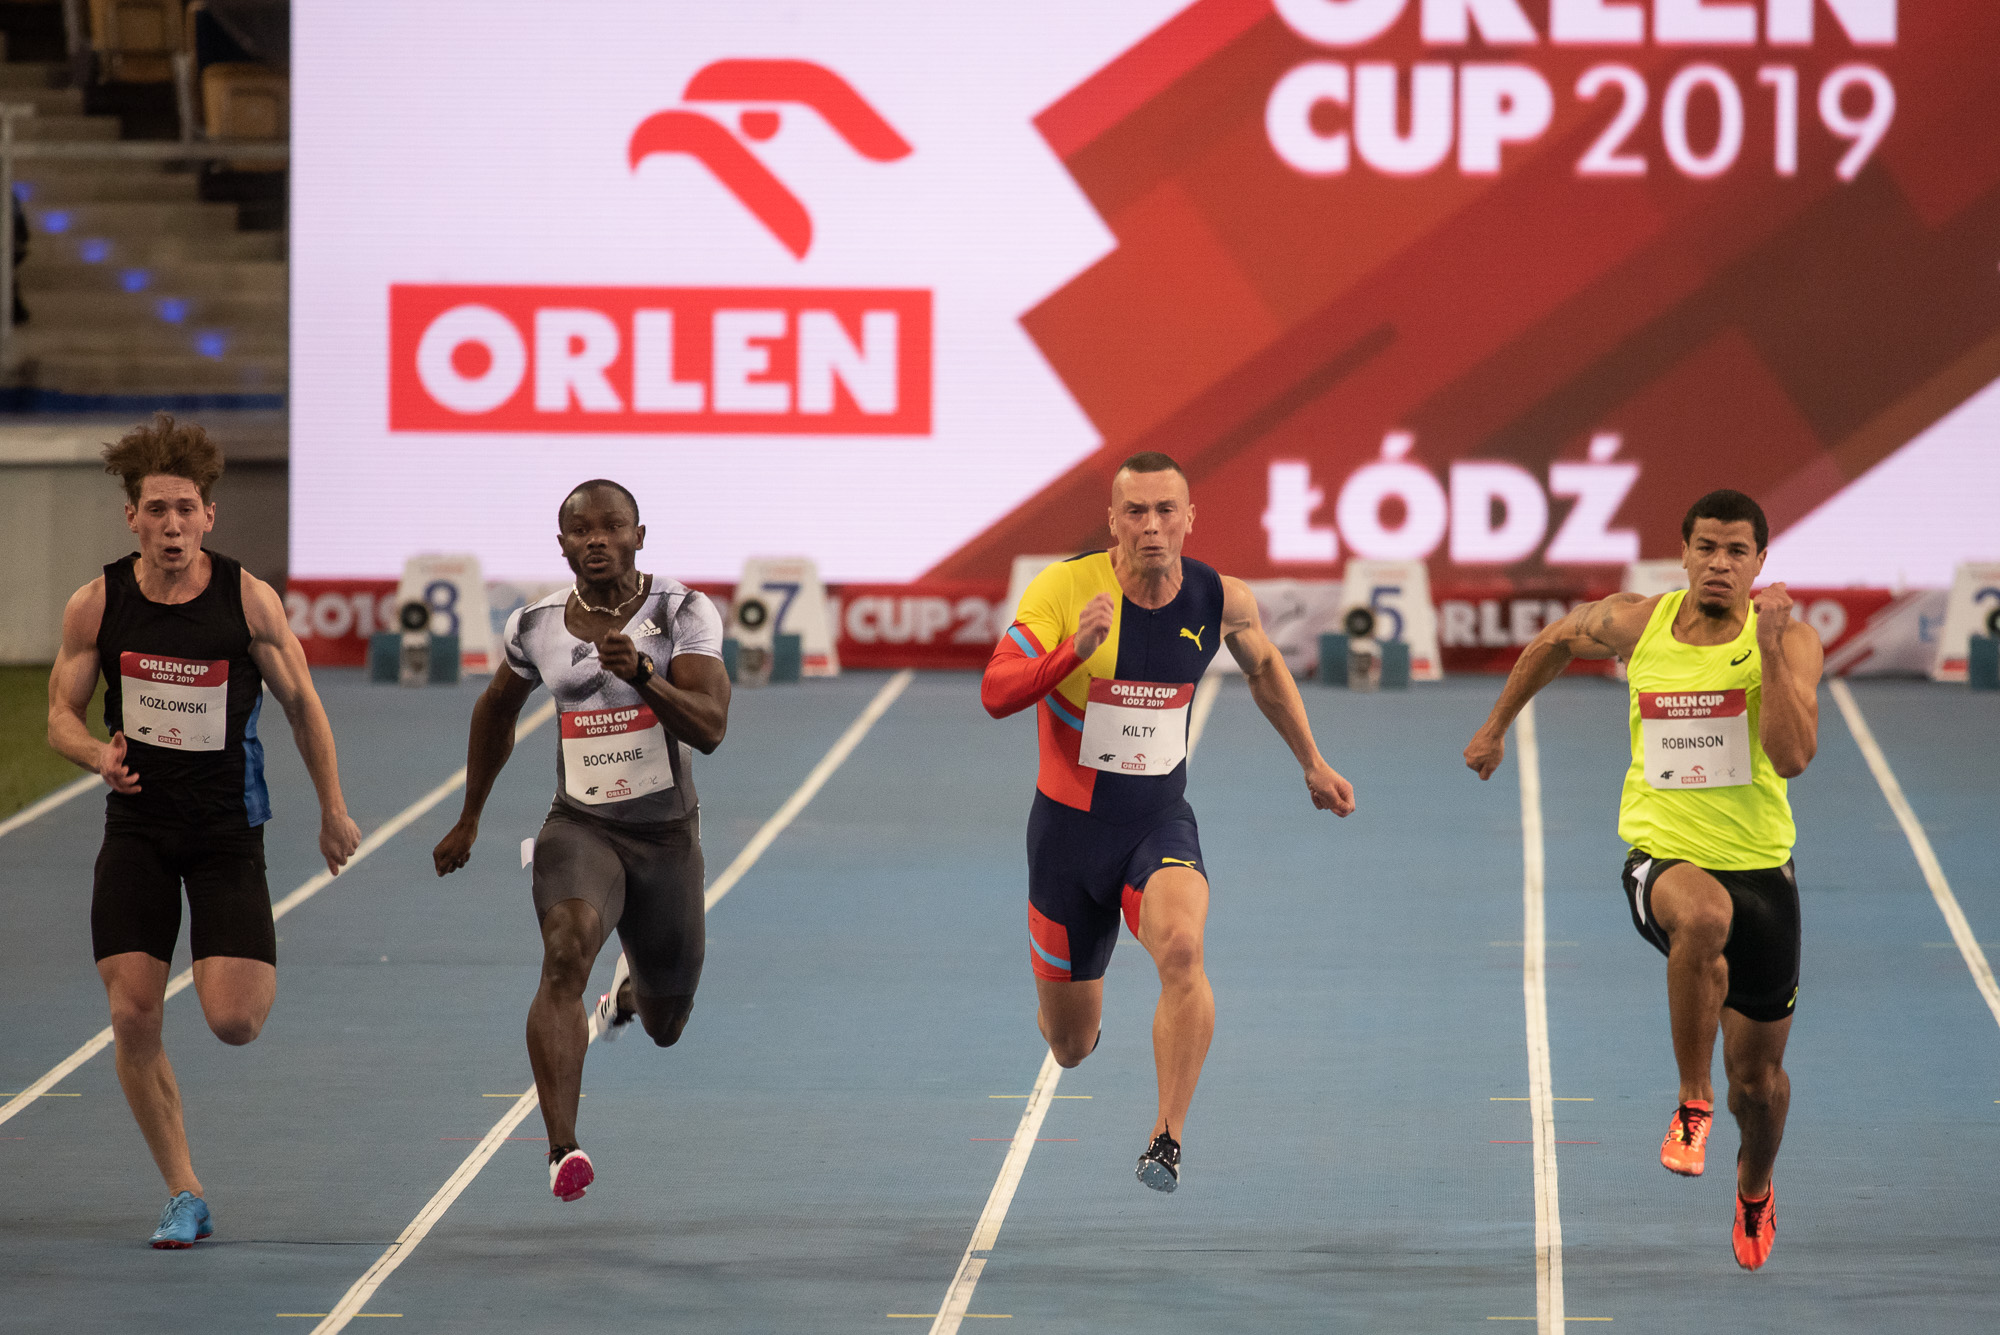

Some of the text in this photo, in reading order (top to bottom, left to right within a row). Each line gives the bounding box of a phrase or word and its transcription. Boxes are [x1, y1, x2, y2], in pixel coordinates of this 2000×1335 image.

[1265, 61, 1897, 182] CUP 2019
[416, 302, 899, 416] ORLEN
[1261, 431, 1641, 564] ŁÓDŹ
[424, 579, 460, 637] 8
[761, 582, 801, 636] 7
[1371, 584, 1404, 643] 5
[848, 596, 951, 644] CUP
[631, 627, 661, 640] adidas
[140, 659, 209, 676] ORLEN CUP
[152, 672, 195, 684] ŁÓDŹ 2019
[1110, 684, 1178, 699] ORLEN CUP
[139, 694, 207, 714] KOZŁOWSKI
[1122, 697, 1165, 707] ŁÓDŹ 2019
[1655, 694, 1725, 708] ORLEN CUP
[574, 709, 639, 727] ORLEN CUP
[1667, 707, 1712, 717] ŁÓDŹ 2019
[138, 726, 152, 735] 4F
[586, 723, 628, 735] ŁÓDŹ 2019
[1121, 725, 1156, 738] KILTY
[159, 736, 181, 745] ORLEN
[1662, 735, 1724, 750] ROBINSON
[583, 748, 643, 767] BOCKARIE
[1098, 753, 1116, 762] 4F
[1660, 770, 1674, 780] 4F
[585, 786, 599, 795] 4F
[607, 789, 630, 798] ORLEN
